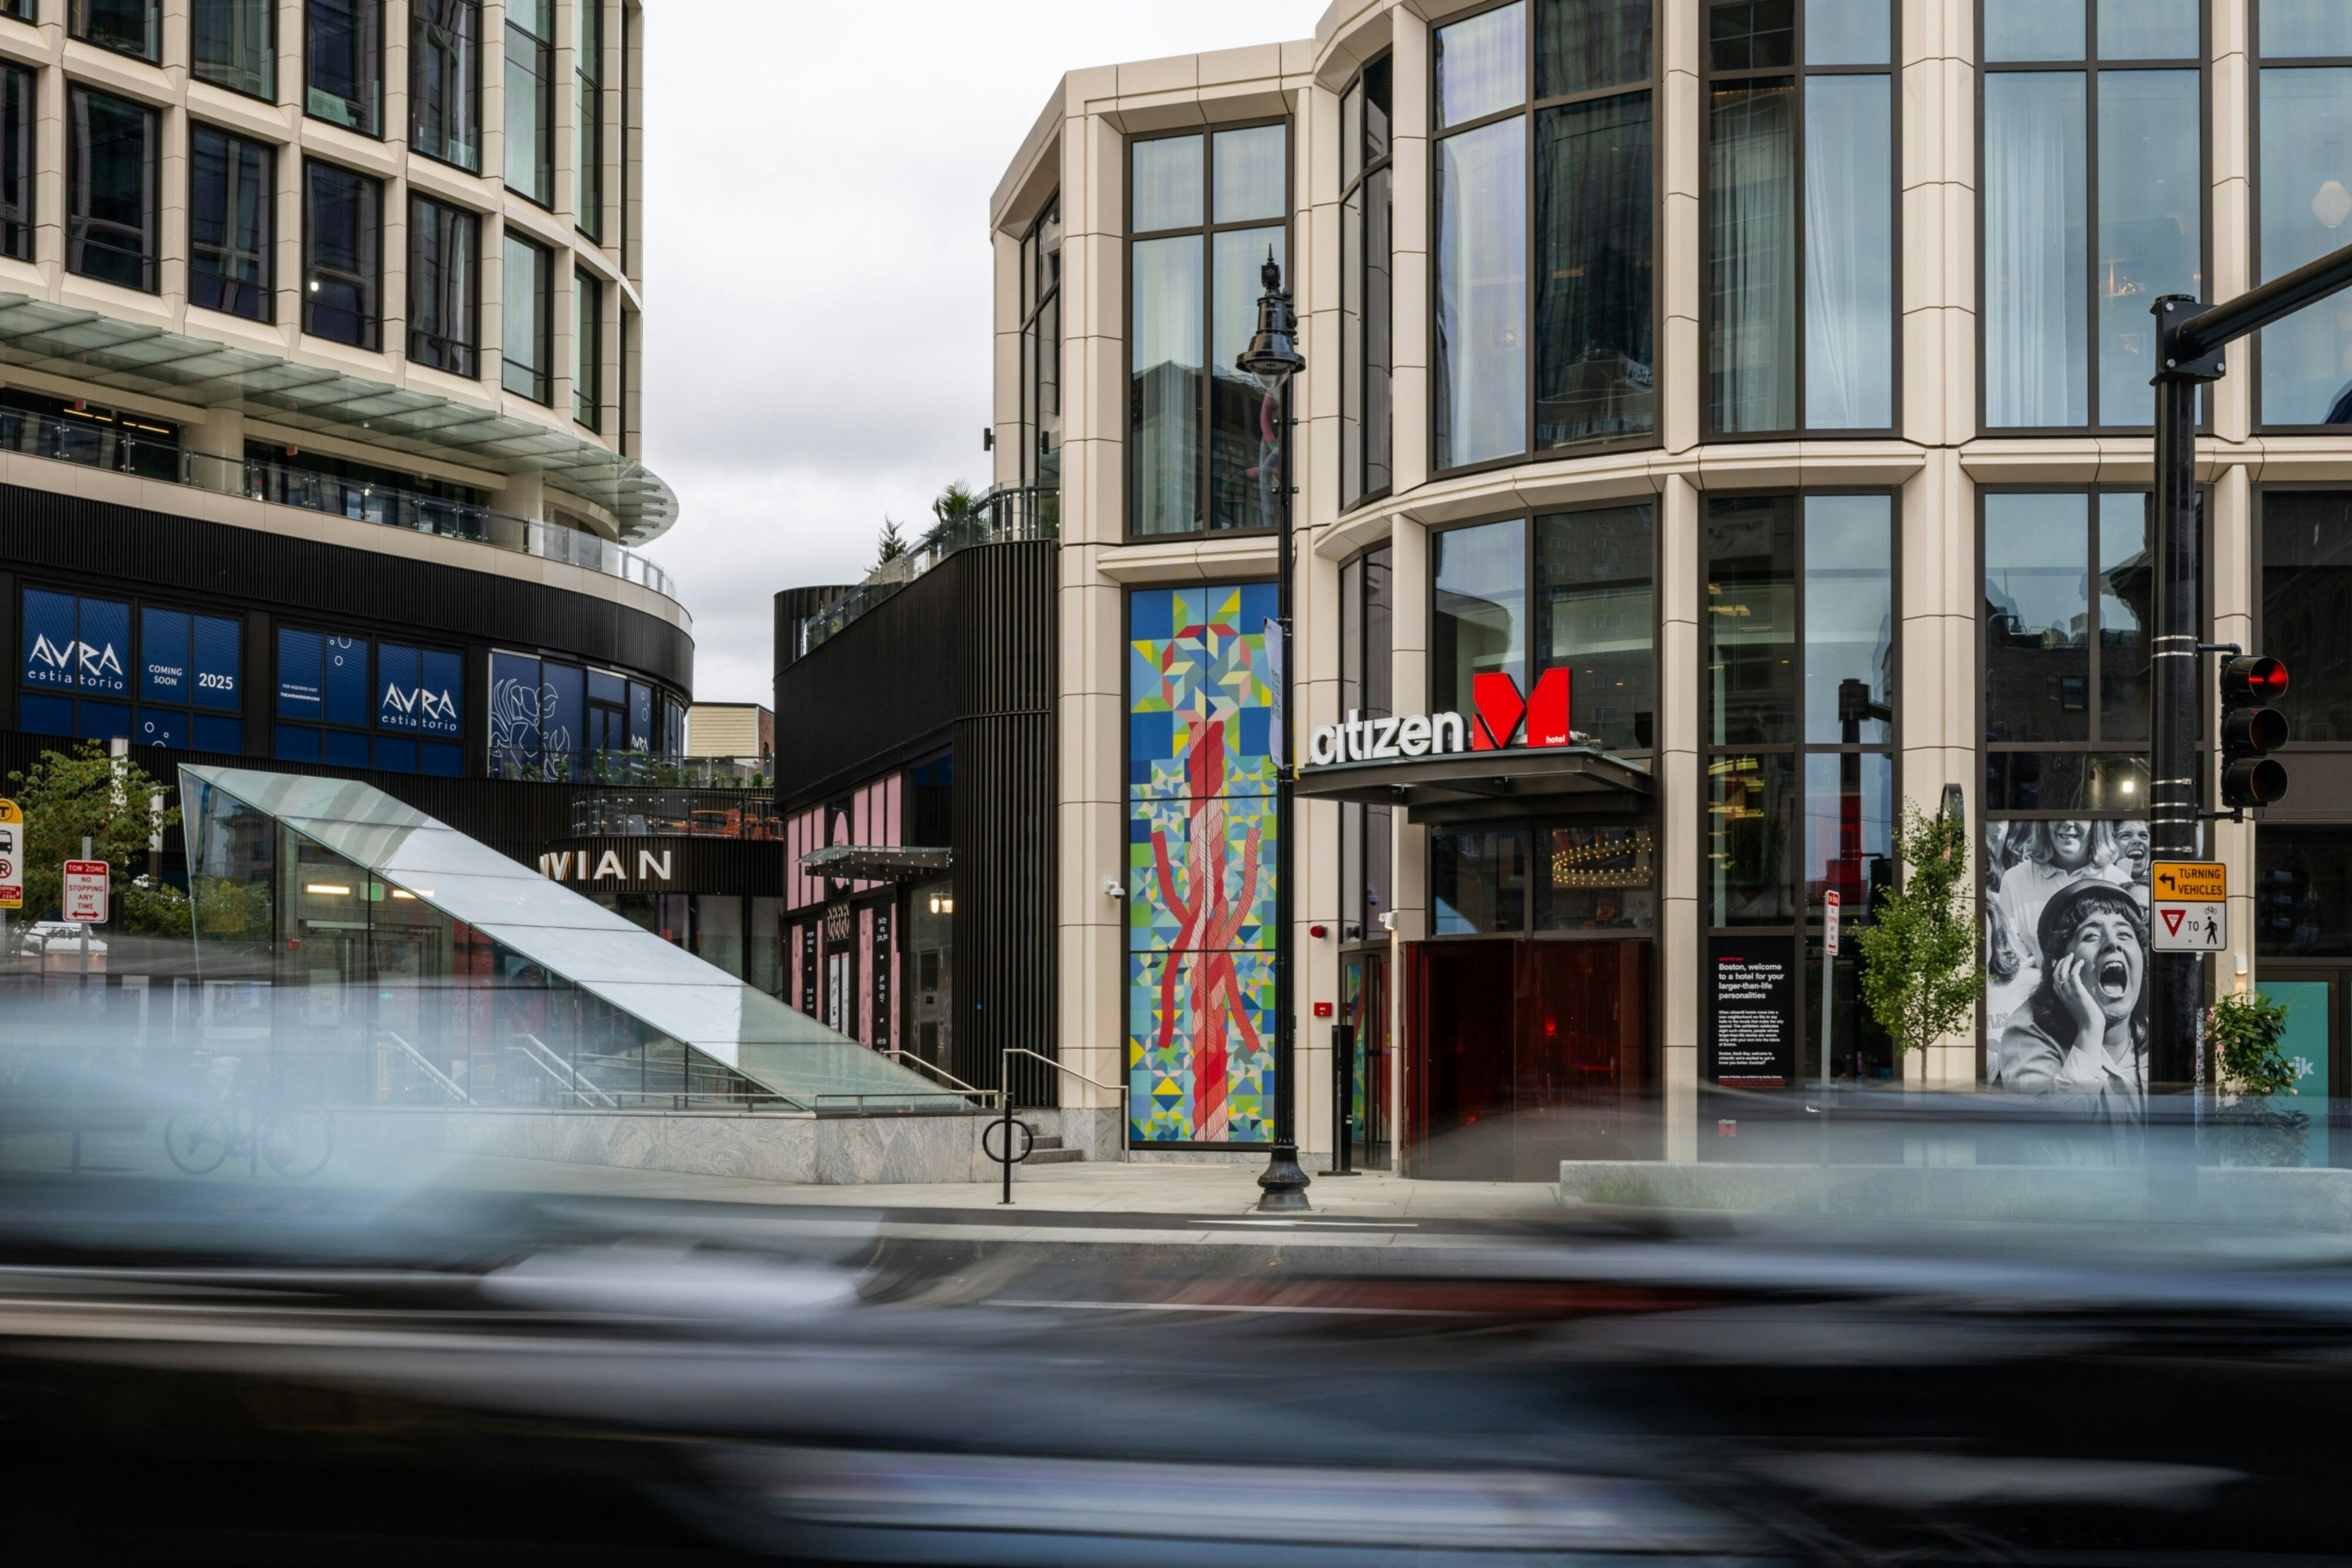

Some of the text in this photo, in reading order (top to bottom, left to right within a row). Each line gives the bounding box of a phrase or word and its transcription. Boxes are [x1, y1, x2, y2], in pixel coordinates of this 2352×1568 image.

[29, 633, 123, 676] AVRA
[149, 664, 182, 677] COMING
[28, 670, 123, 690] estiatorio
[154, 676, 177, 686] SOON
[199, 673, 233, 690] 2025
[382, 682, 456, 719] AVRA
[382, 715, 456, 731] estiatorio
[1546, 735, 1565, 743] hotel
[2179, 868, 2220, 879] TURNING
[2178, 885, 2223, 895] VEHICLES
[2187, 921, 2199, 931] TO
[1719, 963, 1746, 971] Boston,
[1719, 982, 1772, 991] larger-than-life
[1719, 991, 1766, 1000] personalities
